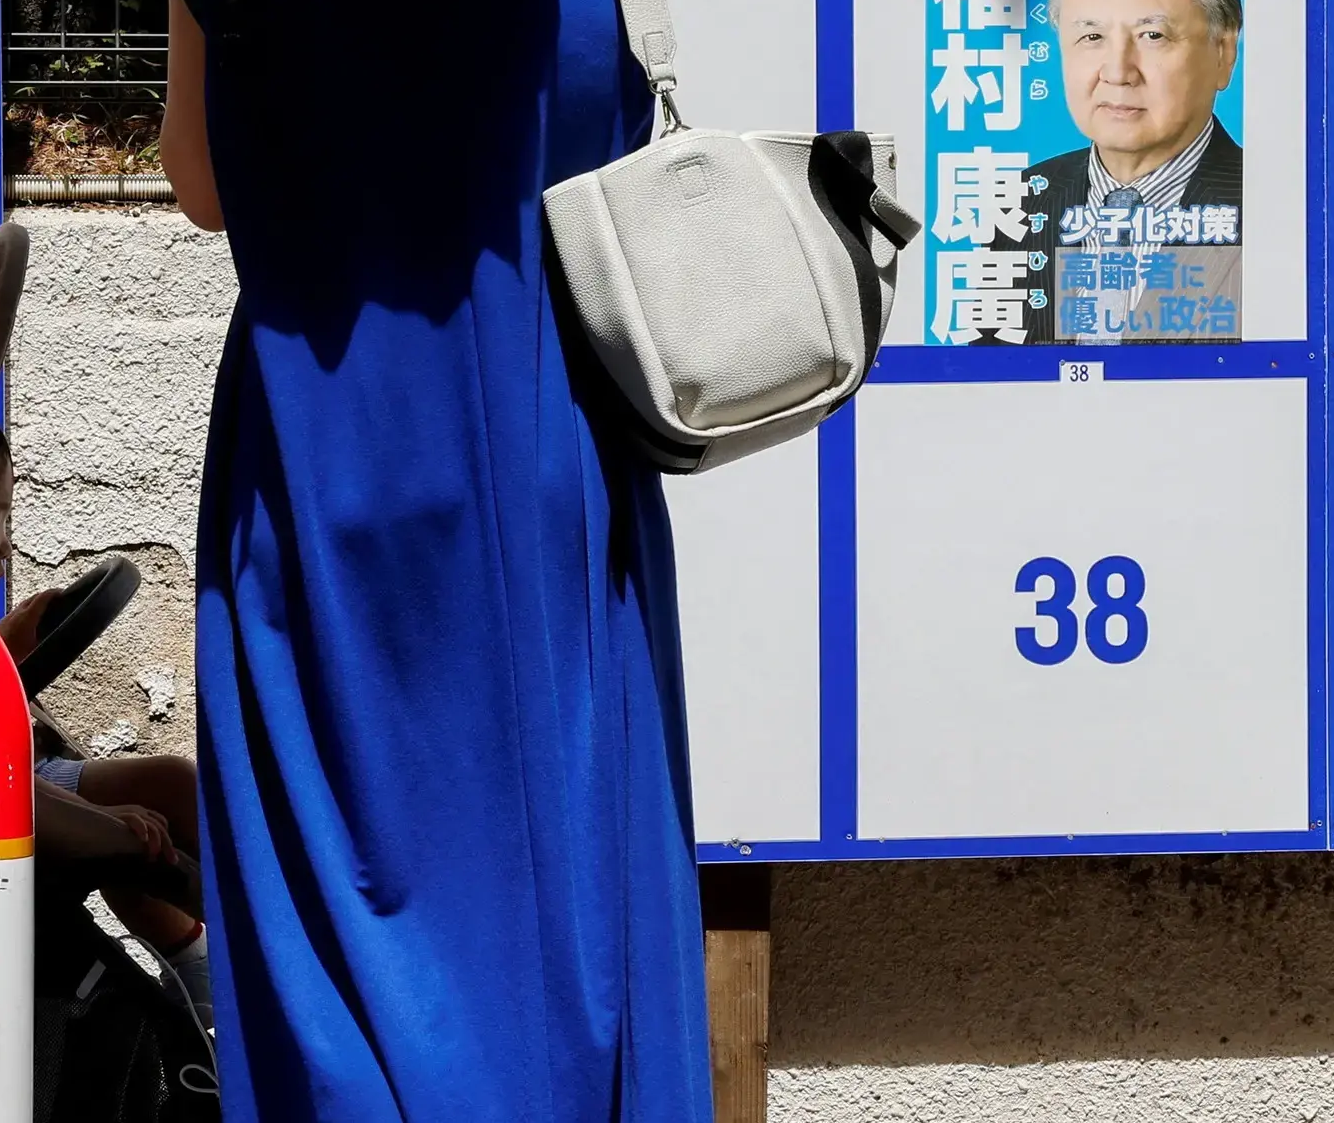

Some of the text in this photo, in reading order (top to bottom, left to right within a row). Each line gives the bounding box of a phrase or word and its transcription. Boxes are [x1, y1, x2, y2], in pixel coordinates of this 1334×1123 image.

[1060, 206, 1239, 244] 少子化対策
[1060, 252, 1205, 292] 高齢者に
[1060, 295, 1236, 335] 優しい政治
[1070, 364, 1089, 381] 38
[1014, 556, 1149, 666] 38
